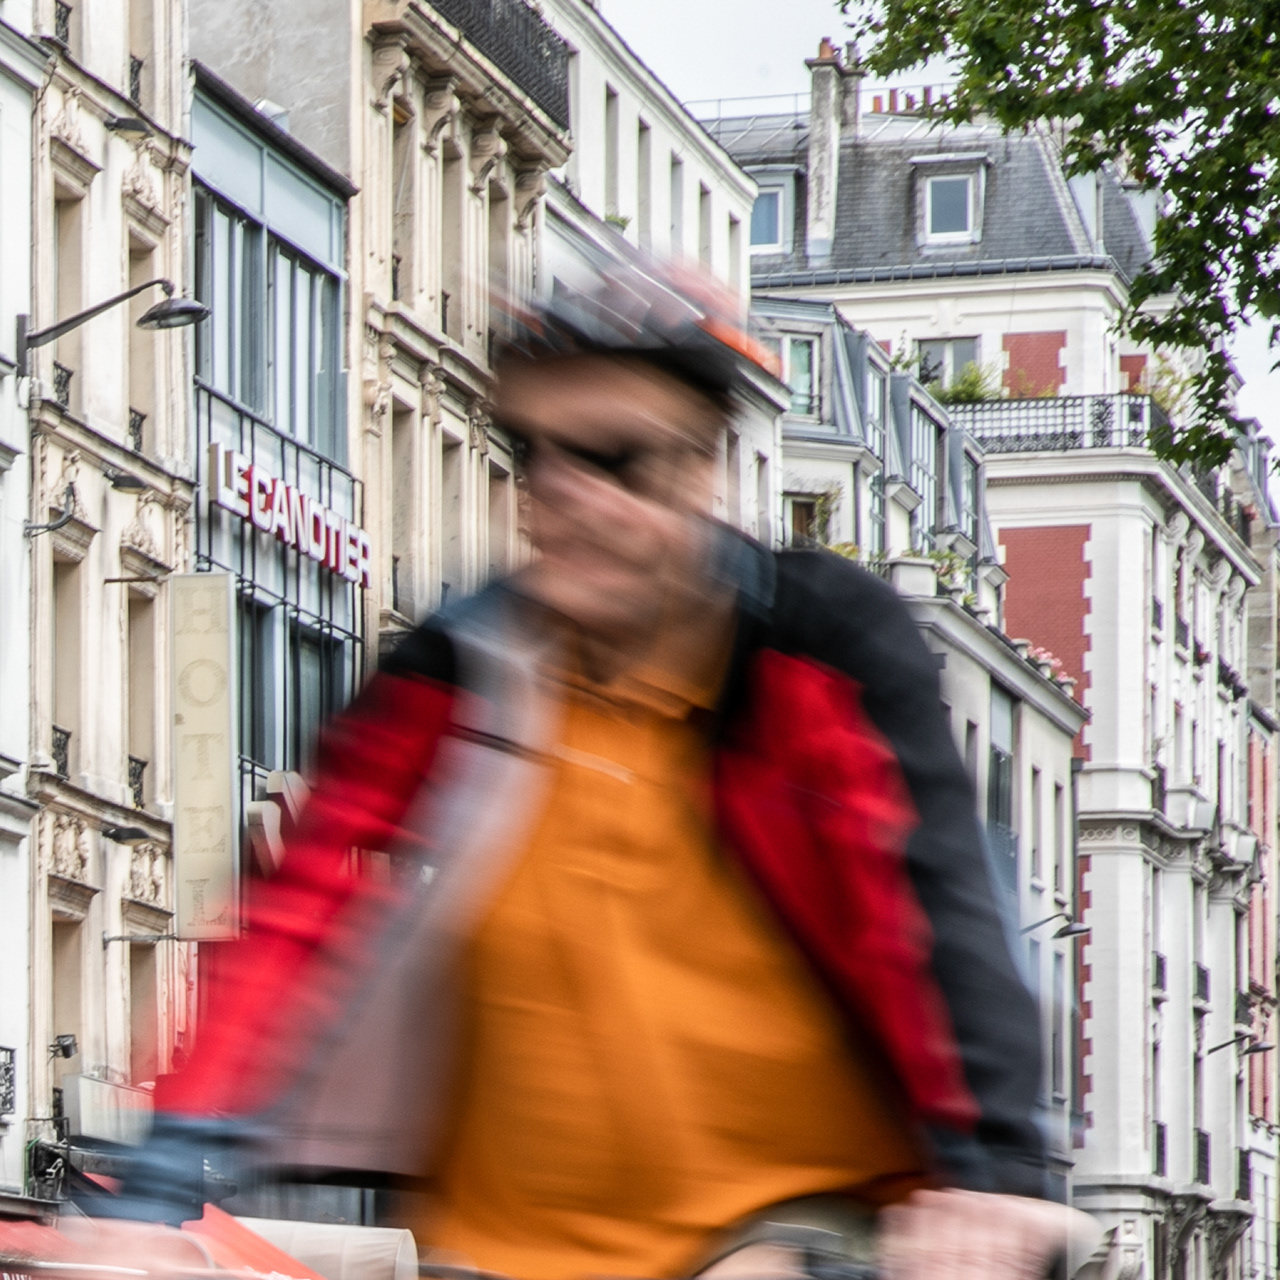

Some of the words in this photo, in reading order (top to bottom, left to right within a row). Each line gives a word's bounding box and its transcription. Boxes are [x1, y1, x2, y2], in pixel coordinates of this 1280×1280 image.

[209, 441, 250, 518] LE
[250, 464, 373, 590] CANOTIER
[174, 586, 229, 927] HOTEL
